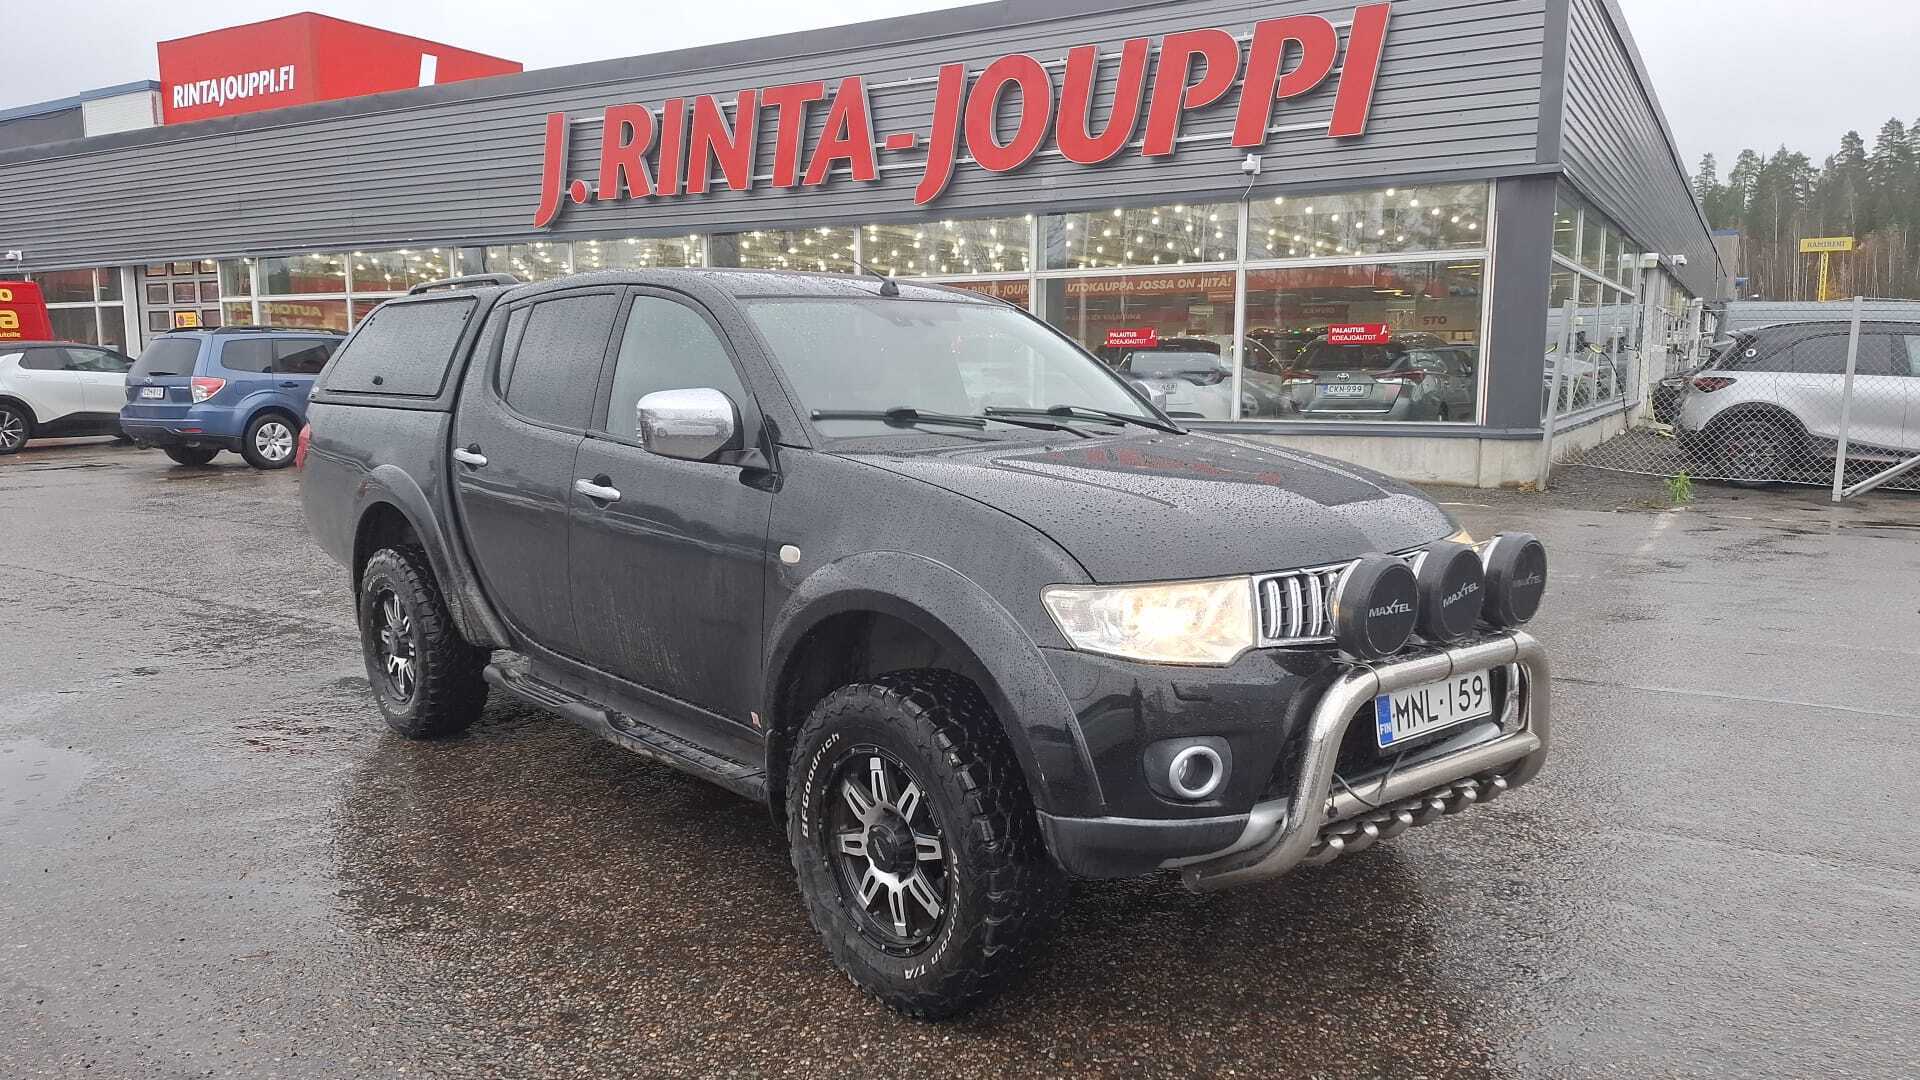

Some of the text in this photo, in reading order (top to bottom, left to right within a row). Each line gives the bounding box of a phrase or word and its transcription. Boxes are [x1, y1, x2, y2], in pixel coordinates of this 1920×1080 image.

[173, 64, 295, 108] RINTAJOUPPI.FI
[535, 2, 1391, 229] J.RINTA-JOUPPI
[1137, 278, 1175, 290] JOSSA
[1177, 278, 1196, 288] ON
[1331, 326, 1365, 334] PALAUTUS
[1442, 582, 1480, 609] MAXTEL
[1368, 599, 1413, 618] MAXTEL
[1394, 675, 1483, 732] MNL-159
[1379, 723, 1392, 735] FIN
[801, 731, 840, 839] BFGoodrich
[904, 964, 926, 980] T/A
